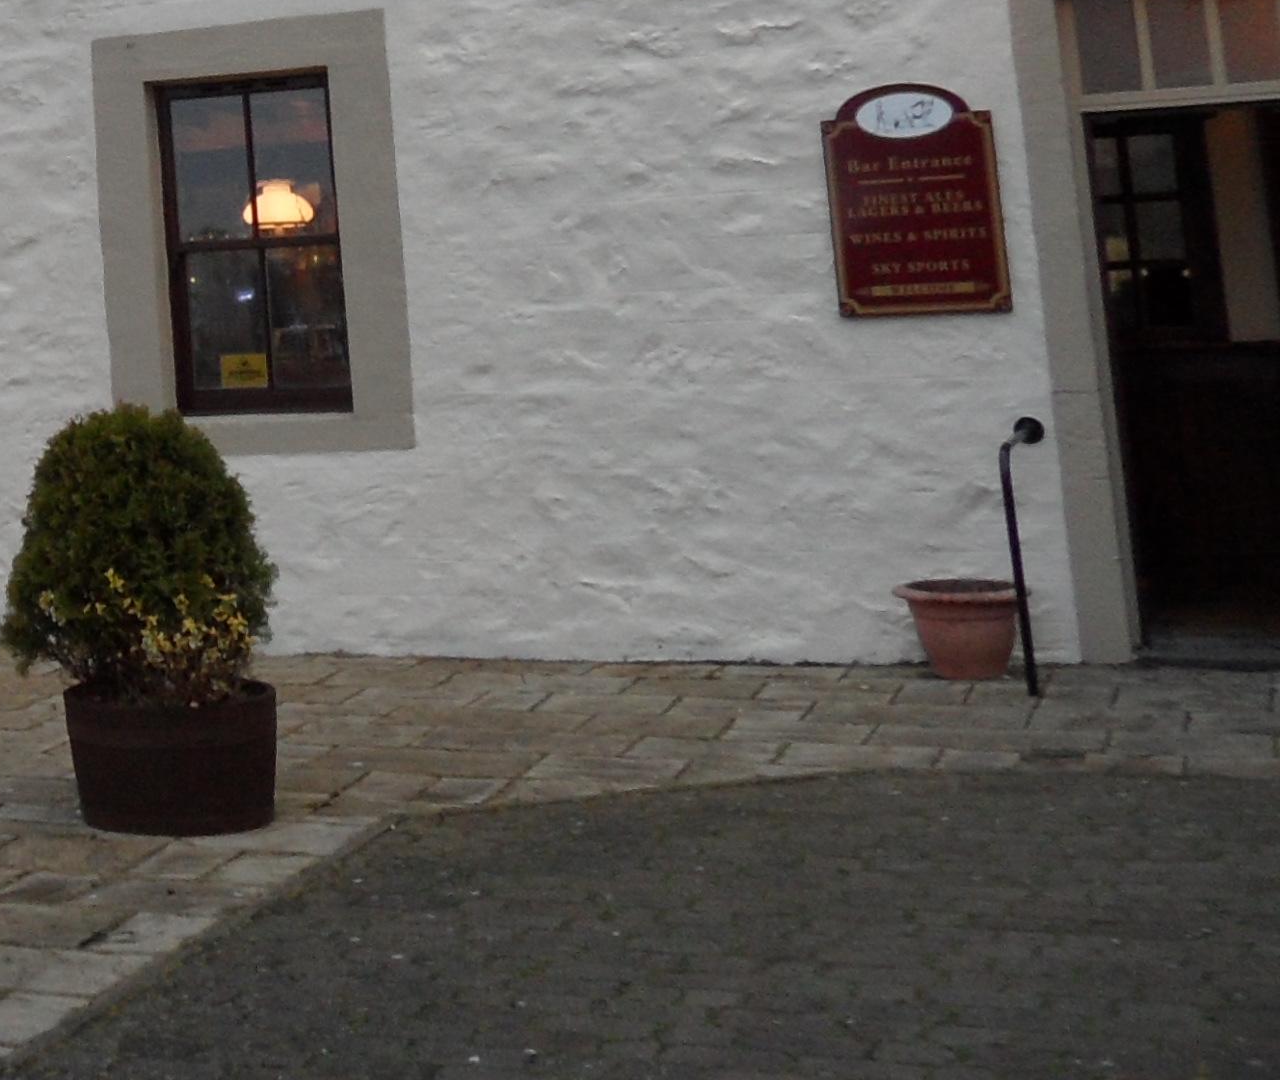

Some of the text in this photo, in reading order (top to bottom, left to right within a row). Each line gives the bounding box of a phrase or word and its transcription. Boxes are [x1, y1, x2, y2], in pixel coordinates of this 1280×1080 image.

[847, 155, 973, 173] Bar Entrance
[864, 189, 964, 207] FINEST ALES
[848, 204, 910, 219] LAGERS
[931, 200, 984, 214] BEERS
[849, 231, 902, 245] WINES
[923, 226, 987, 241] SPIRITS
[872, 258, 971, 275] SKY SPORTS
